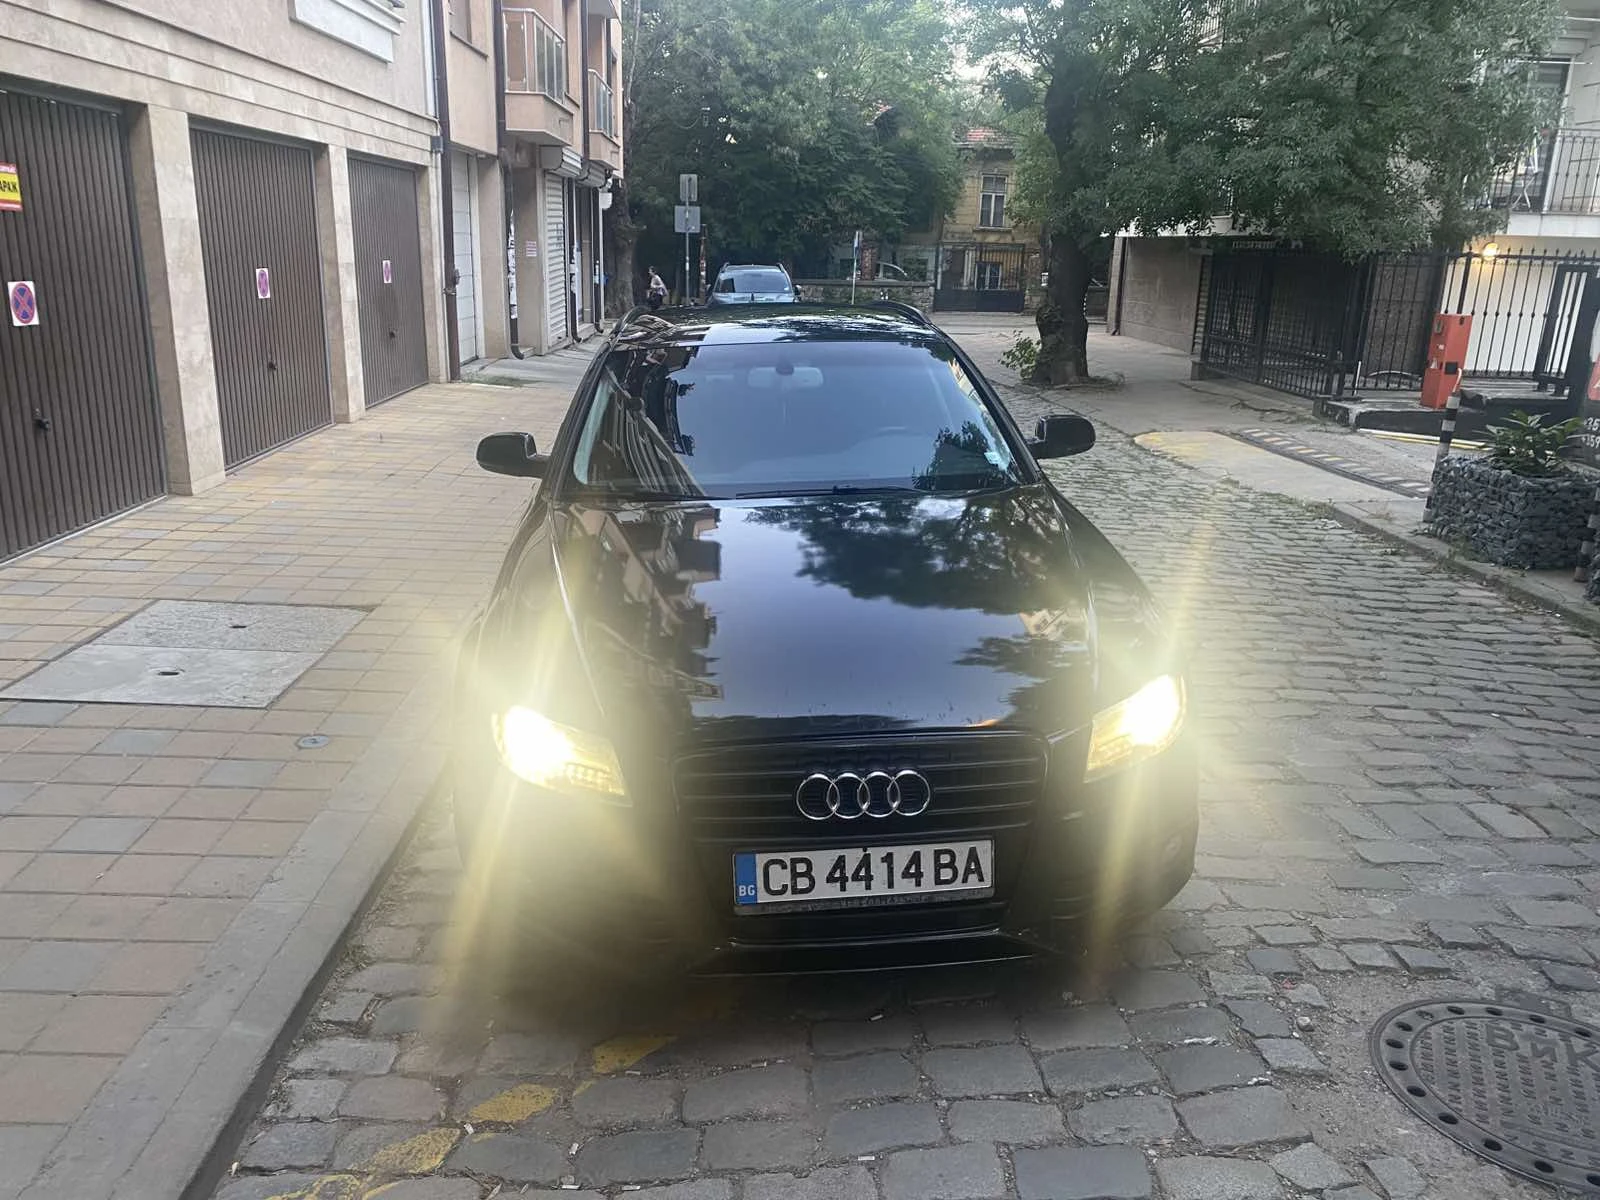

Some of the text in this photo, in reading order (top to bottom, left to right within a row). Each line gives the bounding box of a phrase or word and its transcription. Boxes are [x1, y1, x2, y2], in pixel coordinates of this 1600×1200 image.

[762, 846, 985, 896] CB 4414 BA
[738, 884, 755, 897] BG
